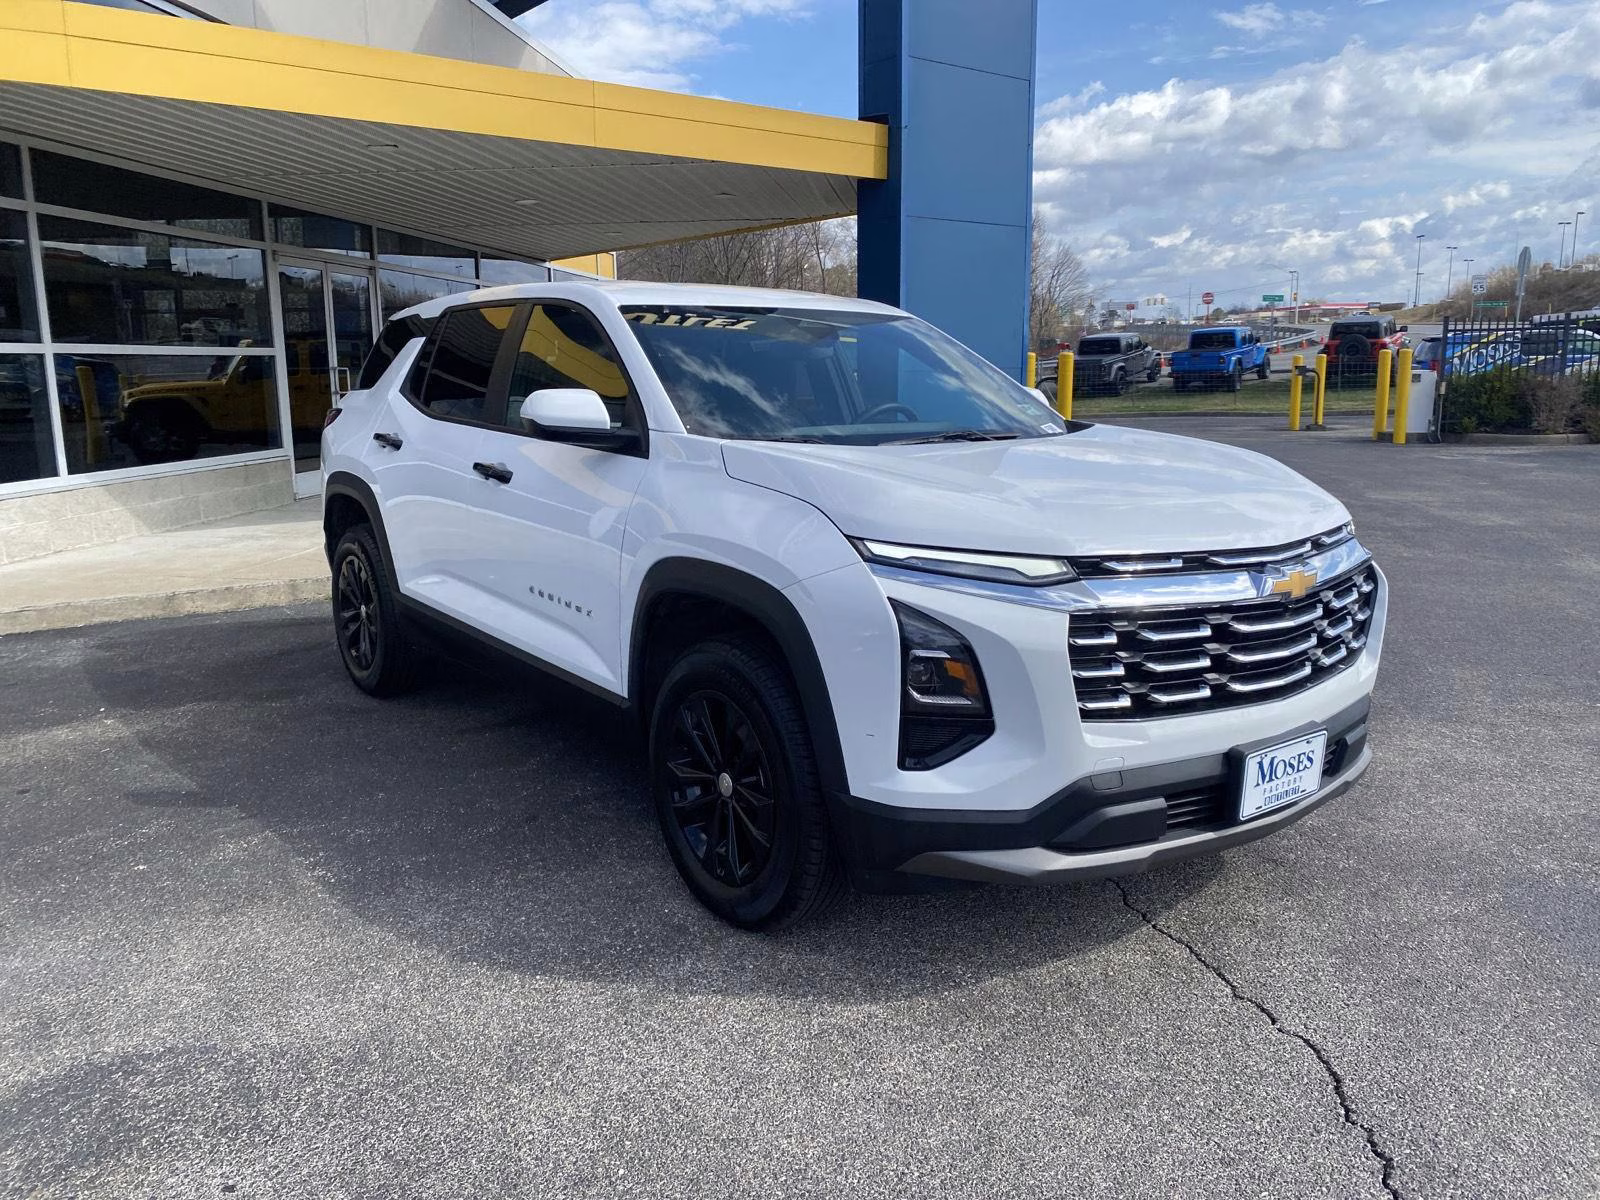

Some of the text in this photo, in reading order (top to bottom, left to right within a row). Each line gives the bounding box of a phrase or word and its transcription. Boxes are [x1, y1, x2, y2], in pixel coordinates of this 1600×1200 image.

[1473, 284, 1485, 292] 55
[528, 585, 593, 617] EQUINOX
[1254, 749, 1315, 788] MOSES
[1263, 775, 1303, 796] FACTORY
